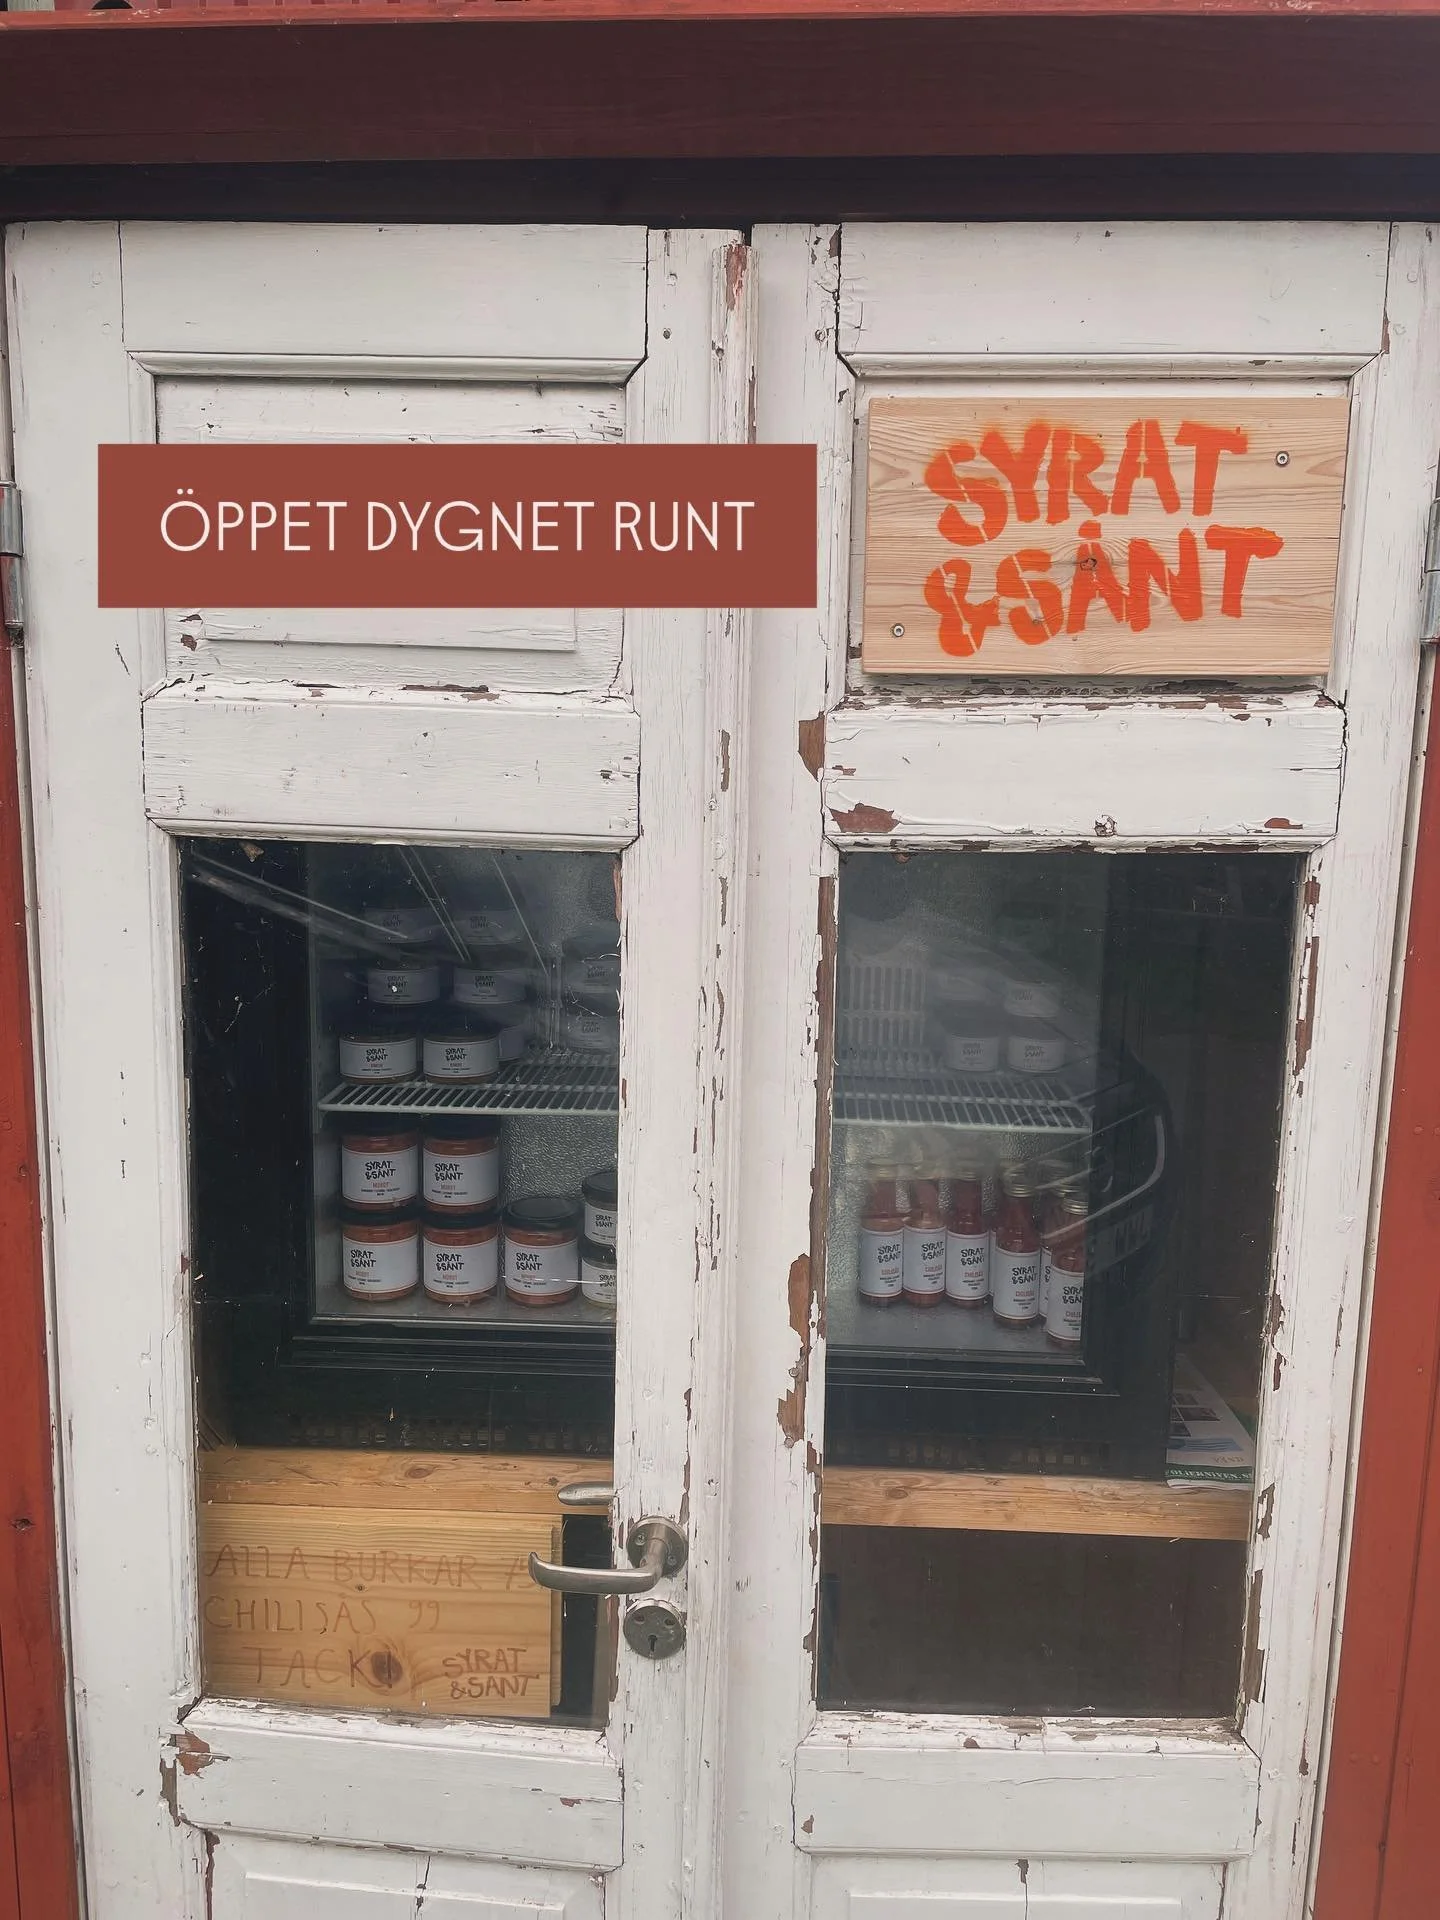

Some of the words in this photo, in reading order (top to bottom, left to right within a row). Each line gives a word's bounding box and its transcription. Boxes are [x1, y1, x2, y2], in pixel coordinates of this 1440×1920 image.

[924, 419, 1248, 547] SYRAT
[364, 1160, 393, 1172] SYRAT
[434, 1162, 460, 1173] SYRAT
[921, 1241, 944, 1254] SYRAT
[350, 1248, 374, 1261] SYRAT
[436, 1252, 462, 1264] SYRAT
[515, 1251, 540, 1263] SYRAT
[1011, 1265, 1037, 1277] SYRAT
[204, 1543, 310, 1580] ALLA
[333, 1550, 483, 1590] BURKAR
[408, 1599, 441, 1631] 99
[442, 1647, 527, 1679] SYRAT
